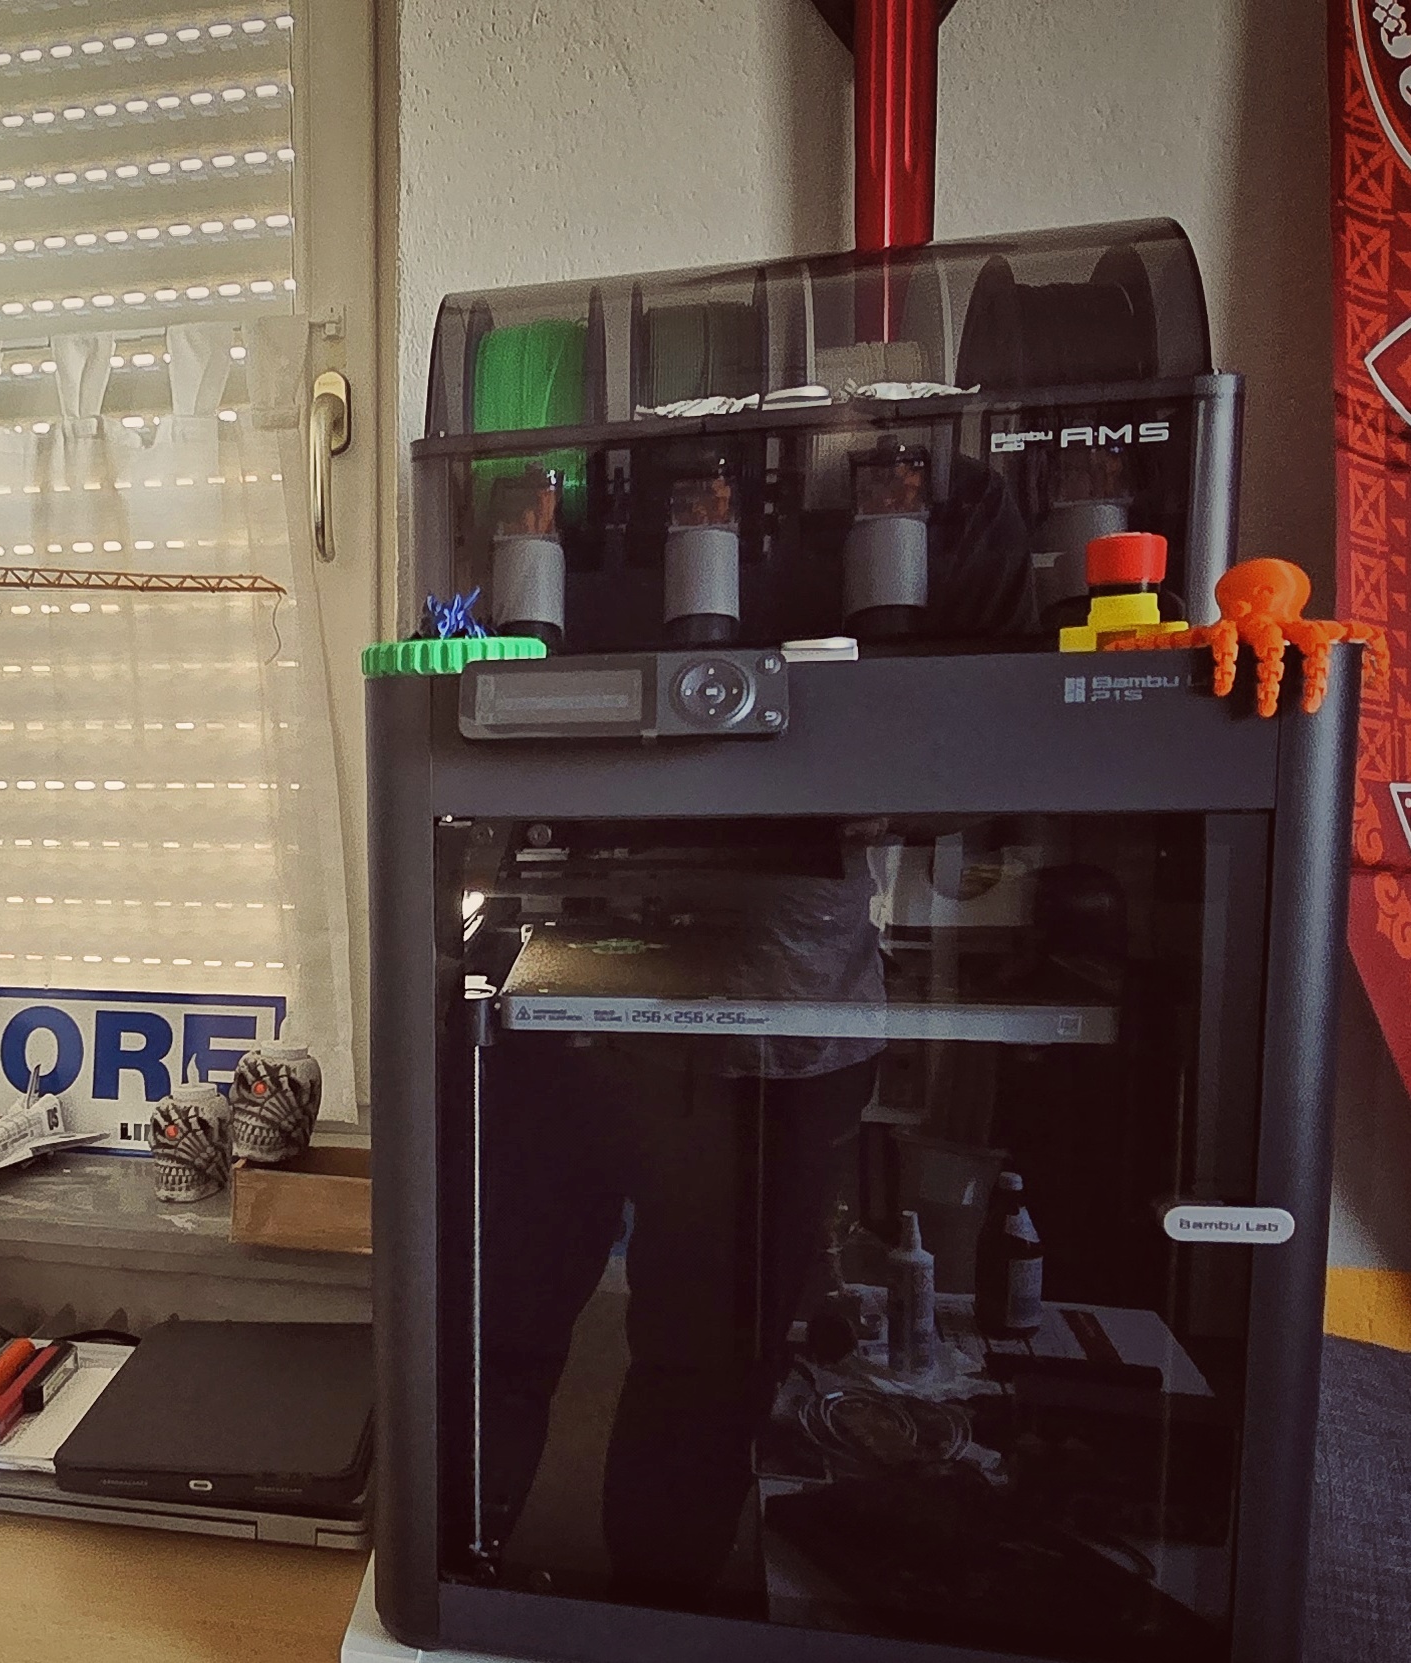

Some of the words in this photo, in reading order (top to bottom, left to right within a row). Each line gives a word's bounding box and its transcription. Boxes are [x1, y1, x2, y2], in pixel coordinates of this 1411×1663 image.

[1060, 421, 1170, 448] AMS
[1092, 674, 1180, 689] Bambu
[1091, 689, 1143, 702] P1S
[1178, 1218, 1241, 1231] Bambu
[1245, 1222, 1279, 1232] Lab
